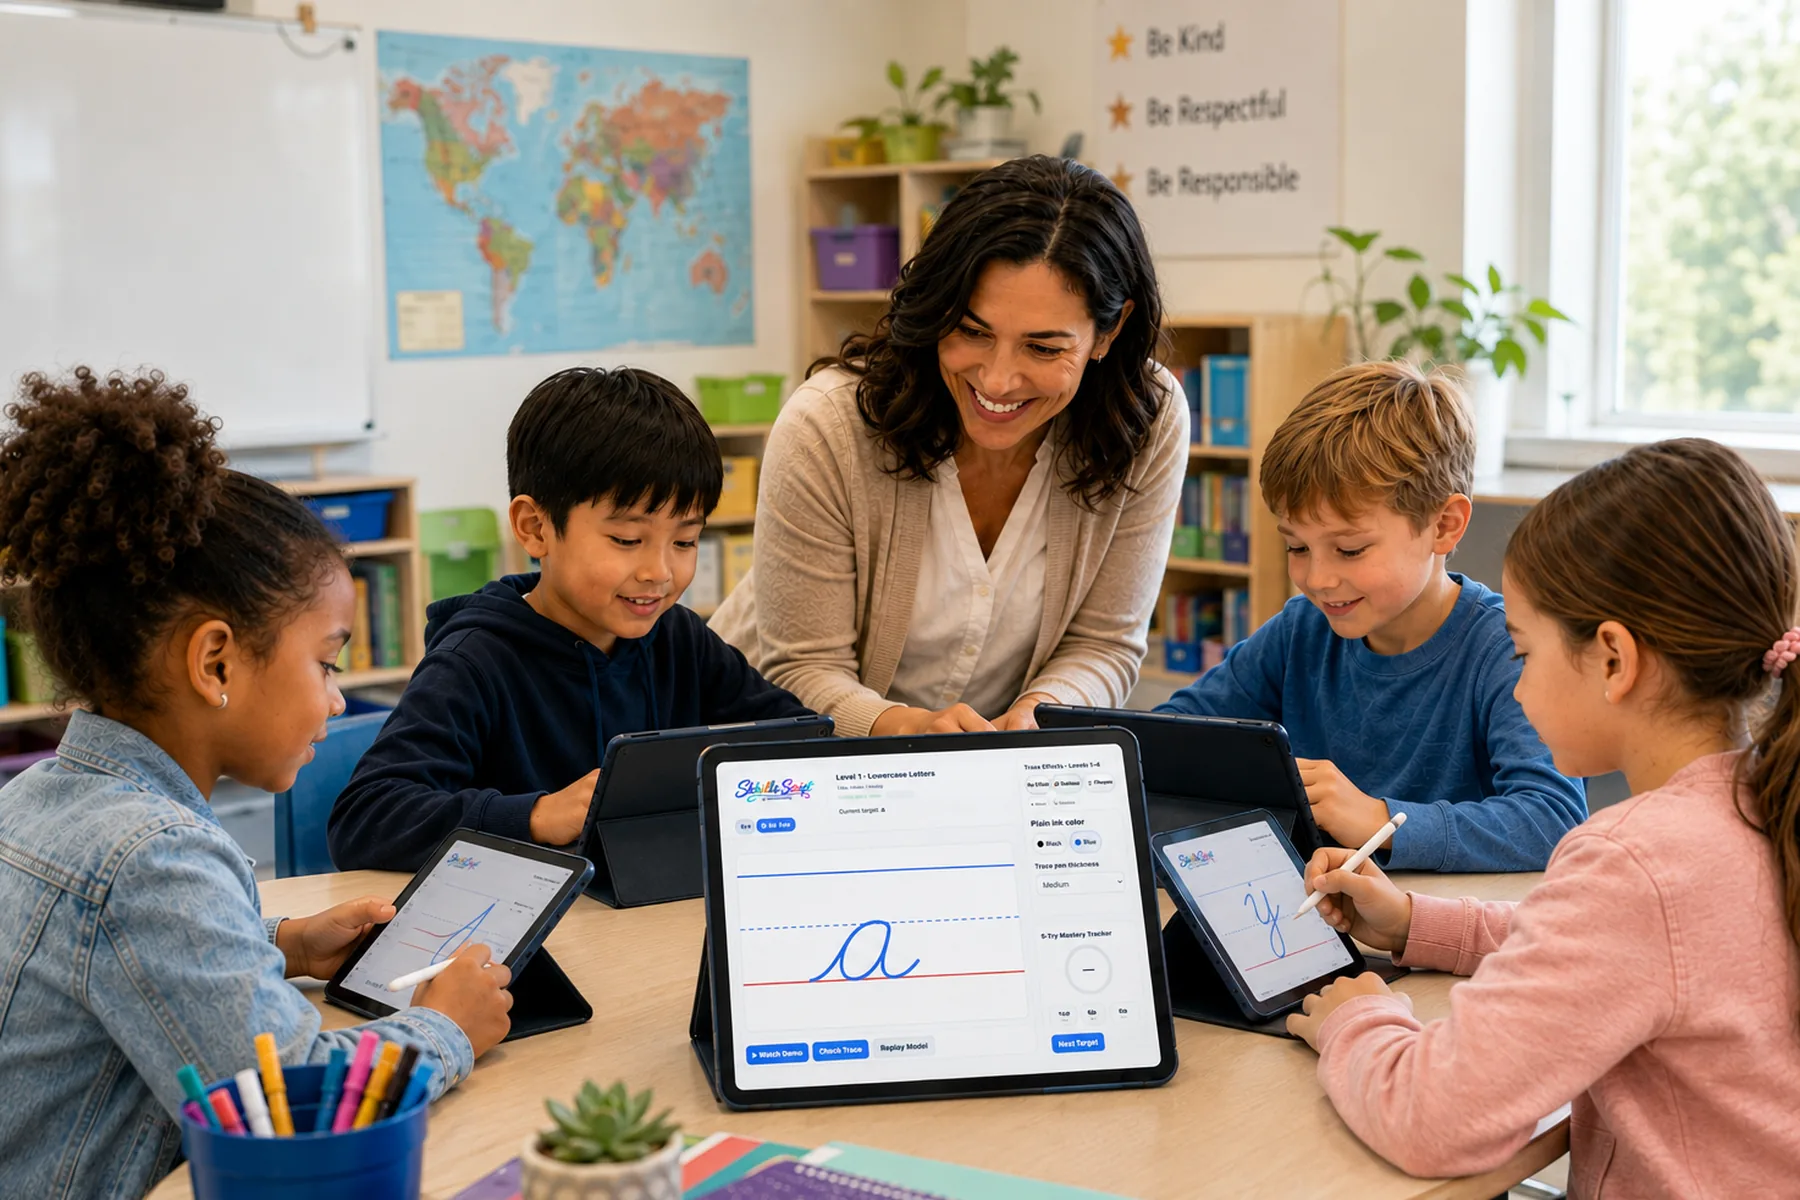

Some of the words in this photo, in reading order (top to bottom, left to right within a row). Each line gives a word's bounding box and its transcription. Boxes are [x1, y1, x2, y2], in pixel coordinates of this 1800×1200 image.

[1147, 27, 1173, 57] Be
[1177, 21, 1225, 54] Kind
[1147, 97, 1172, 126] Be
[1177, 88, 1286, 129] Respectful
[1147, 168, 1172, 196] Be
[1177, 162, 1299, 202] Responsible
[836, 773, 856, 781] Level
[867, 771, 907, 780] Lowercase
[908, 770, 935, 778] Letters
[839, 807, 861, 815] Current
[1030, 819, 1050, 827] Plain
[1052, 818, 1063, 826] ink
[1065, 818, 1084, 826] color
[1054, 862, 1067, 870] pen
[1042, 880, 1070, 888] Medium
[1060, 931, 1085, 939] Mastery
[809, 920, 920, 982] a
[880, 1044, 905, 1052] Replay
[906, 1042, 928, 1050] Model
[1058, 1040, 1075, 1048] Next
[1076, 1039, 1099, 1047] Target
[759, 1050, 781, 1058] Watch
[782, 1049, 803, 1057] Demo
[819, 1047, 841, 1055] Check
[842, 1046, 863, 1054] Trace
